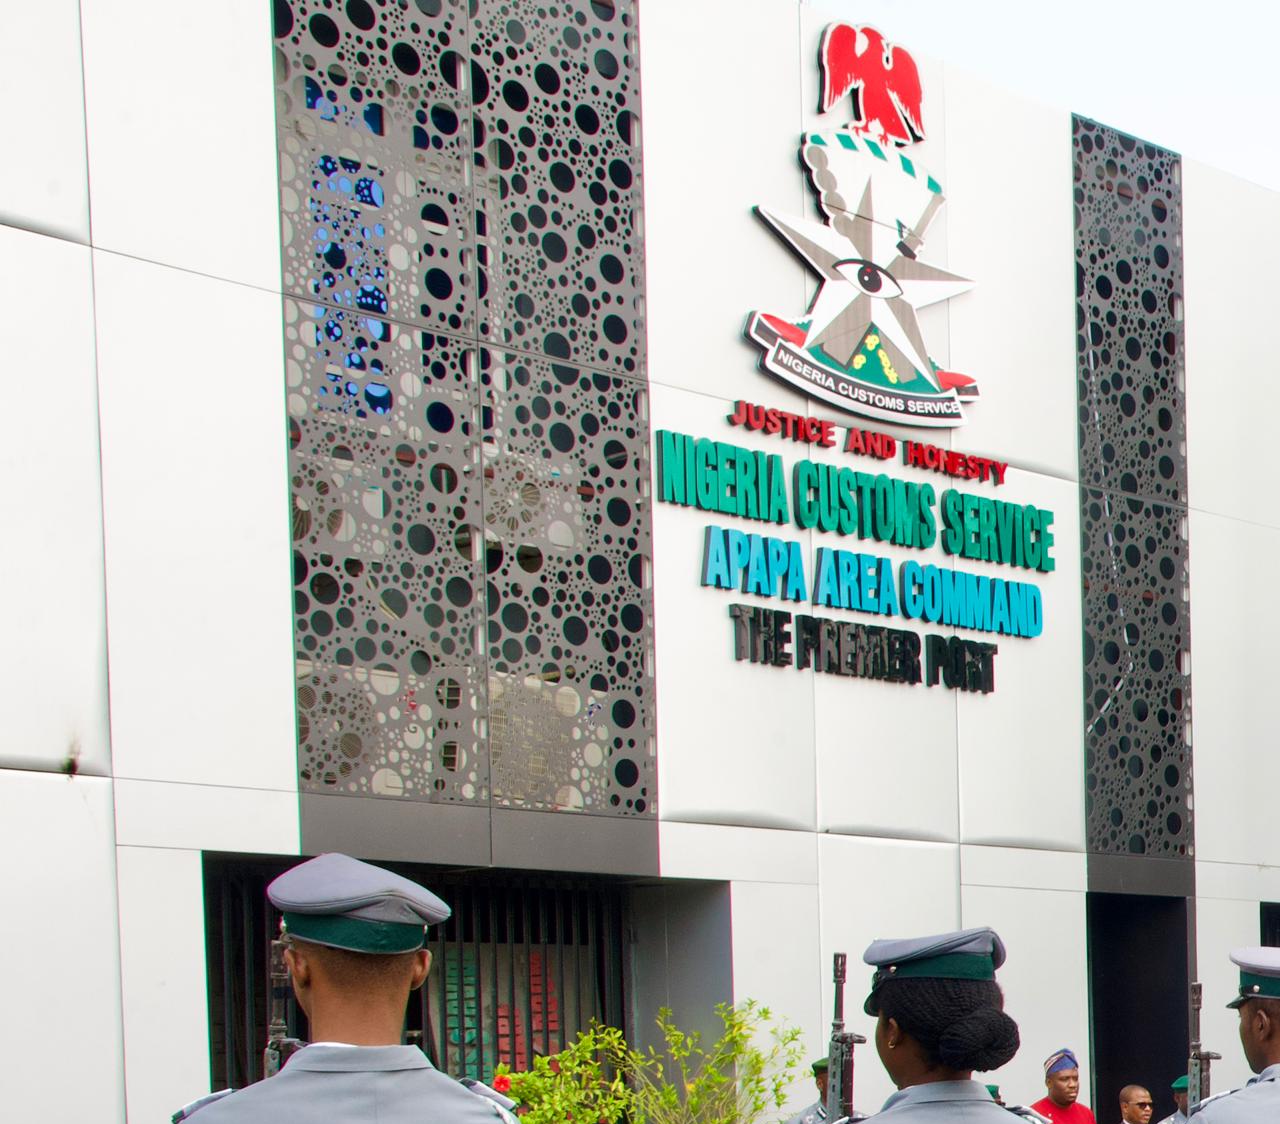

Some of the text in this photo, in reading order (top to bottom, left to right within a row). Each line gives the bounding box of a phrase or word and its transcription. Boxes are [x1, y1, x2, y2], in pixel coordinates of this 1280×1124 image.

[777, 349, 961, 414] NIGERIA CUSTOMS SERVICE
[728, 400, 1009, 486] JUSTICE AND HONESTY
[656, 430, 1056, 573] NIGERIA CUSTOMS SERVICE
[701, 525, 1043, 639] APAPA AREA COMMAND
[729, 603, 998, 694] THE PREMIER PORT
